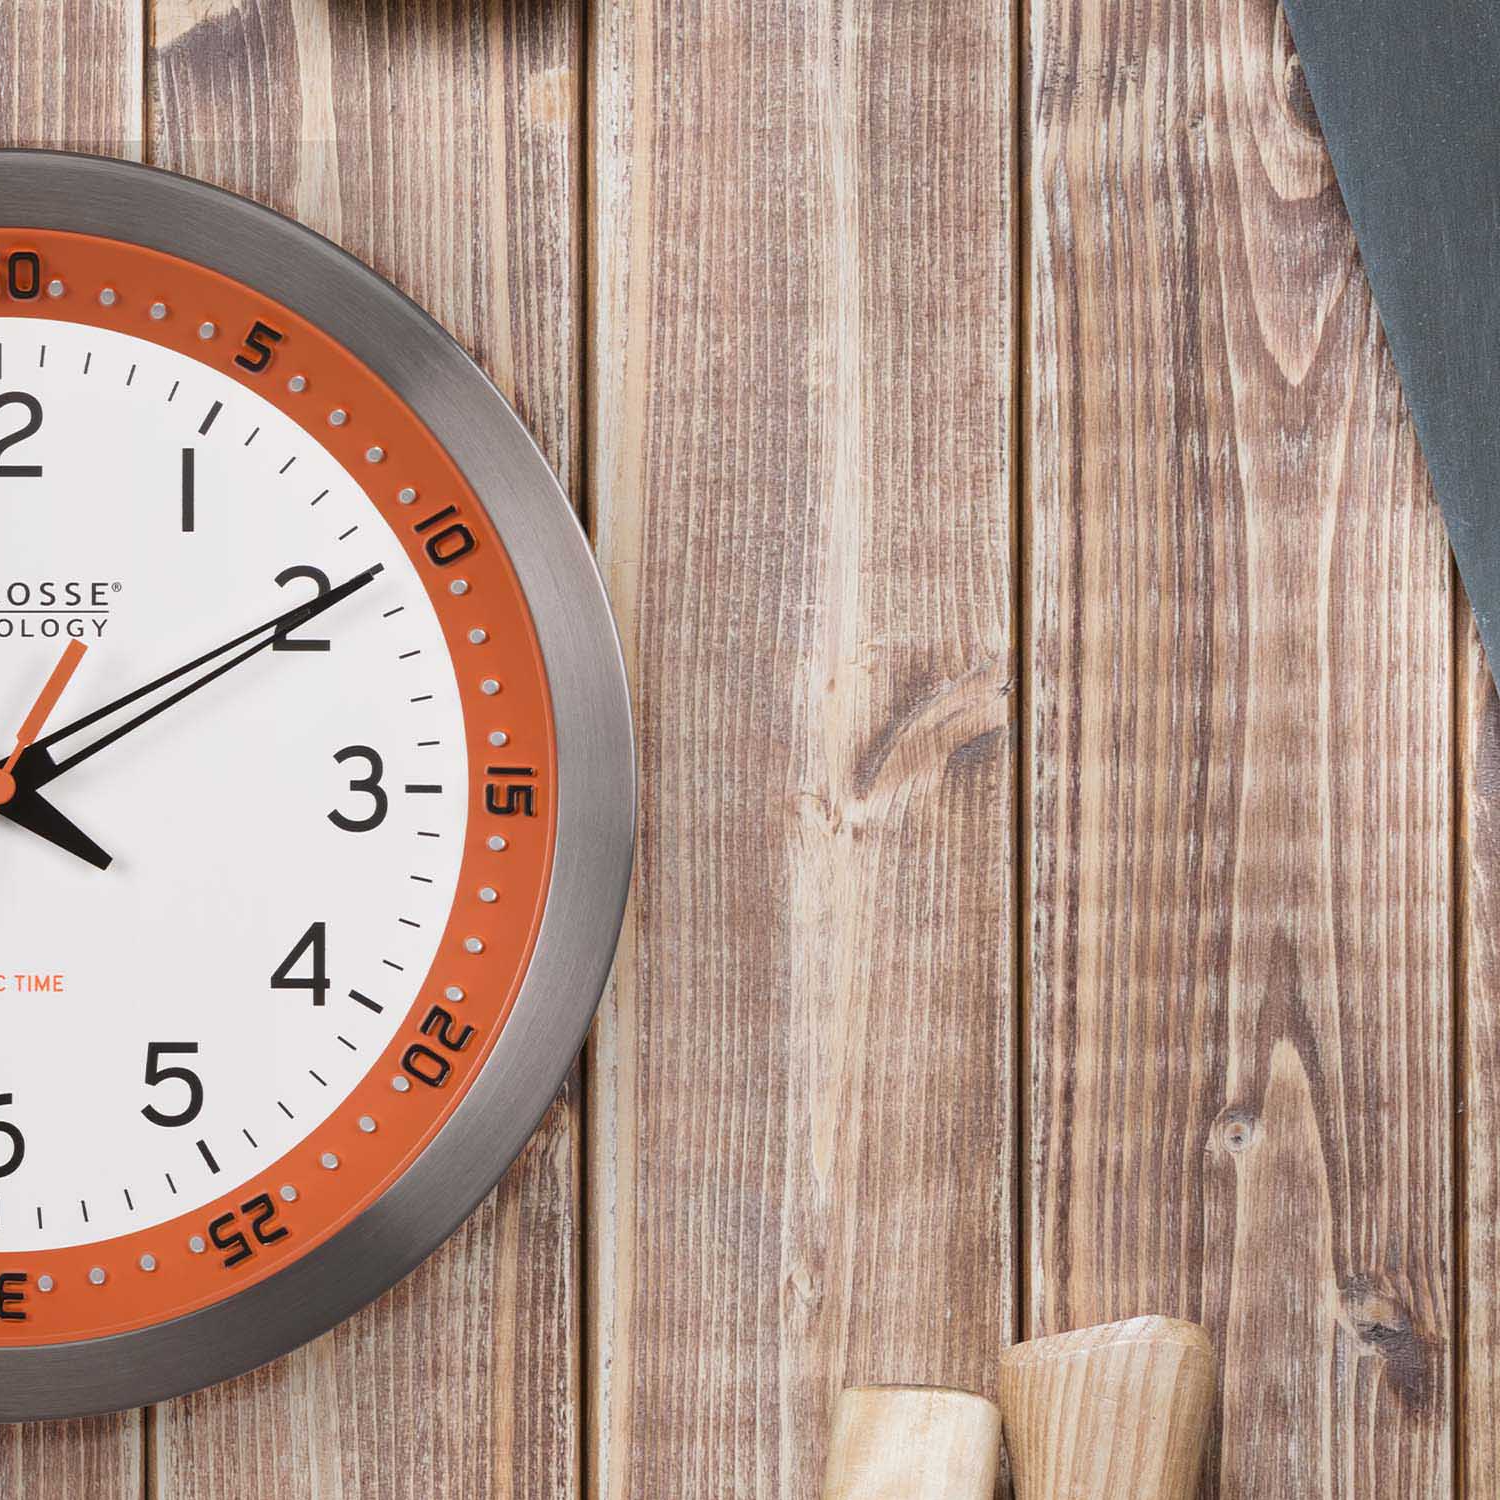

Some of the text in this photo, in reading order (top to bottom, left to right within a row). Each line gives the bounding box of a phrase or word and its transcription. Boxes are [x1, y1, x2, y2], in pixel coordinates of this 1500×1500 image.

[234, 321, 283, 373] 5
[181, 447, 195, 533] 1
[414, 505, 475, 566] 10
[272, 564, 331, 651] 2
[326, 745, 389, 833] 3
[485, 767, 535, 817] 15
[14, 973, 64, 992] TIME
[270, 921, 331, 1007] 4
[140, 1041, 204, 1128] 5
[402, 1005, 475, 1088] 20
[208, 1193, 289, 1268] 25
